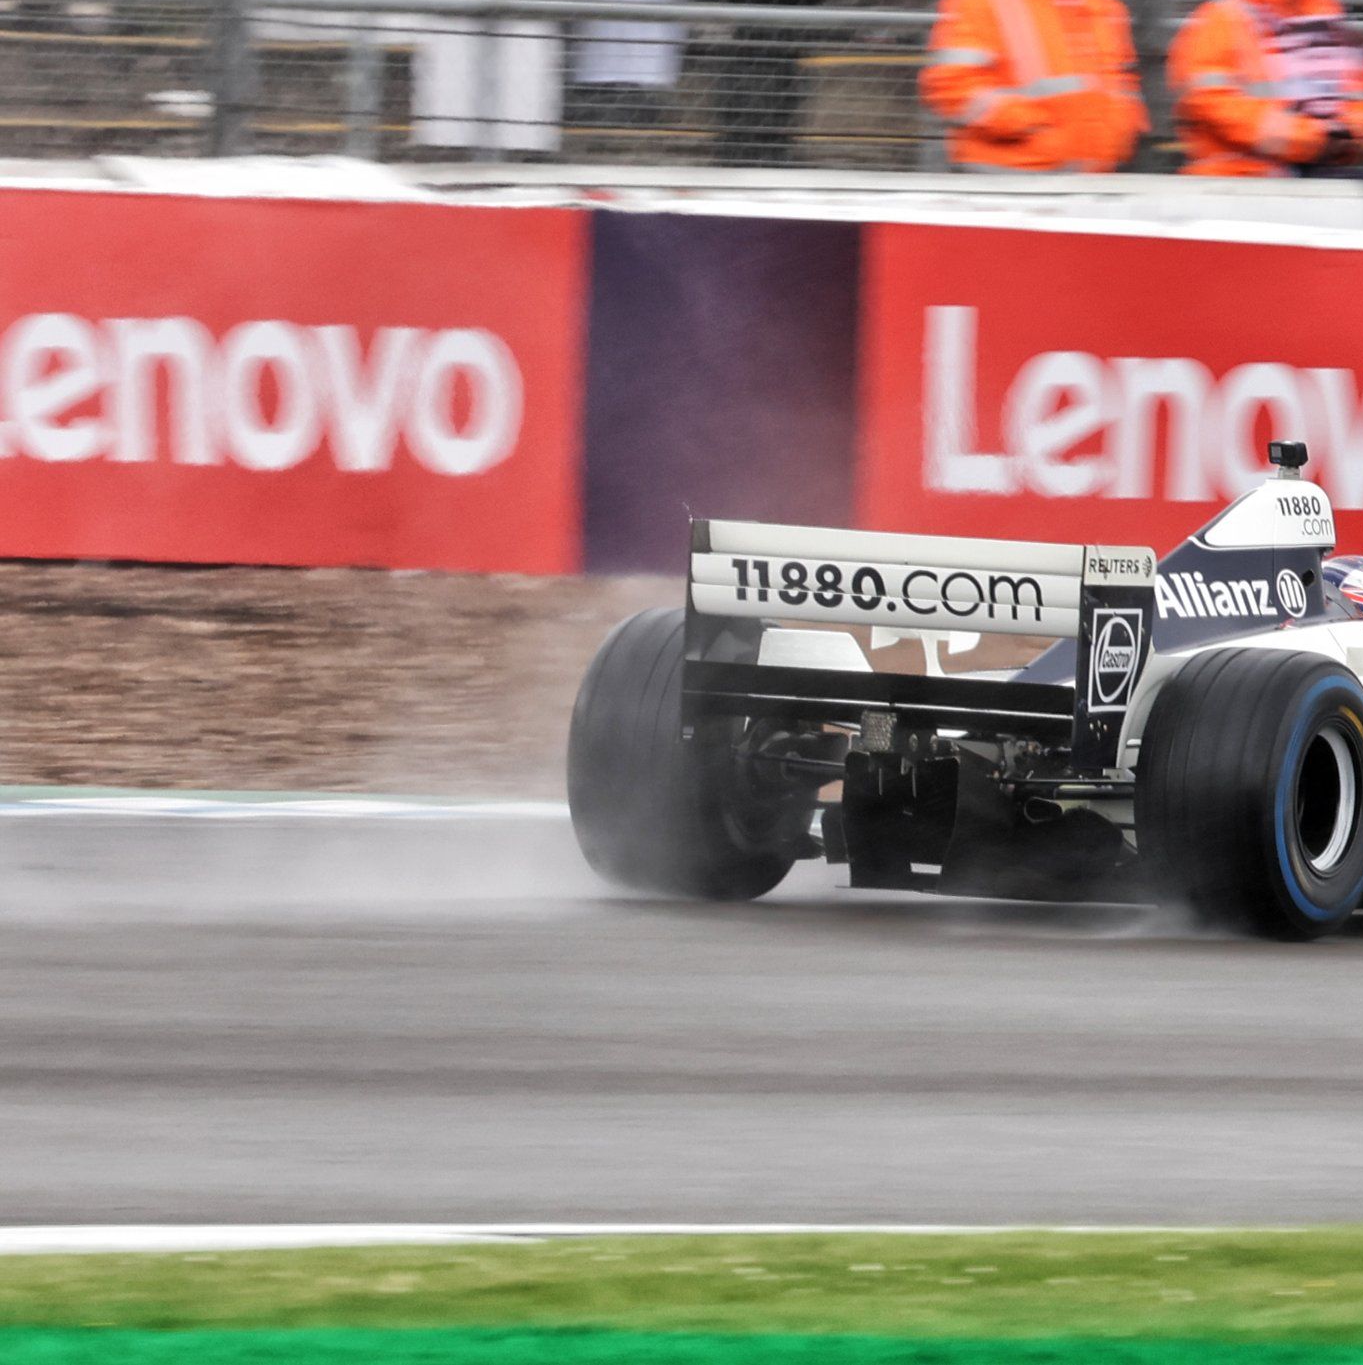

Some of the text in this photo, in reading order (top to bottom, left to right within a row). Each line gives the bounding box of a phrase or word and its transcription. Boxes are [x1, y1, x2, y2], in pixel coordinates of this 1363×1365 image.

[0, 312, 525, 476] enovo
[1277, 496, 1321, 516] 11880
[1302, 518, 1332, 536] .com
[1089, 558, 1139, 574] REUTERS
[732, 558, 1043, 621] 11880.com
[1154, 571, 1278, 619] Allianz
